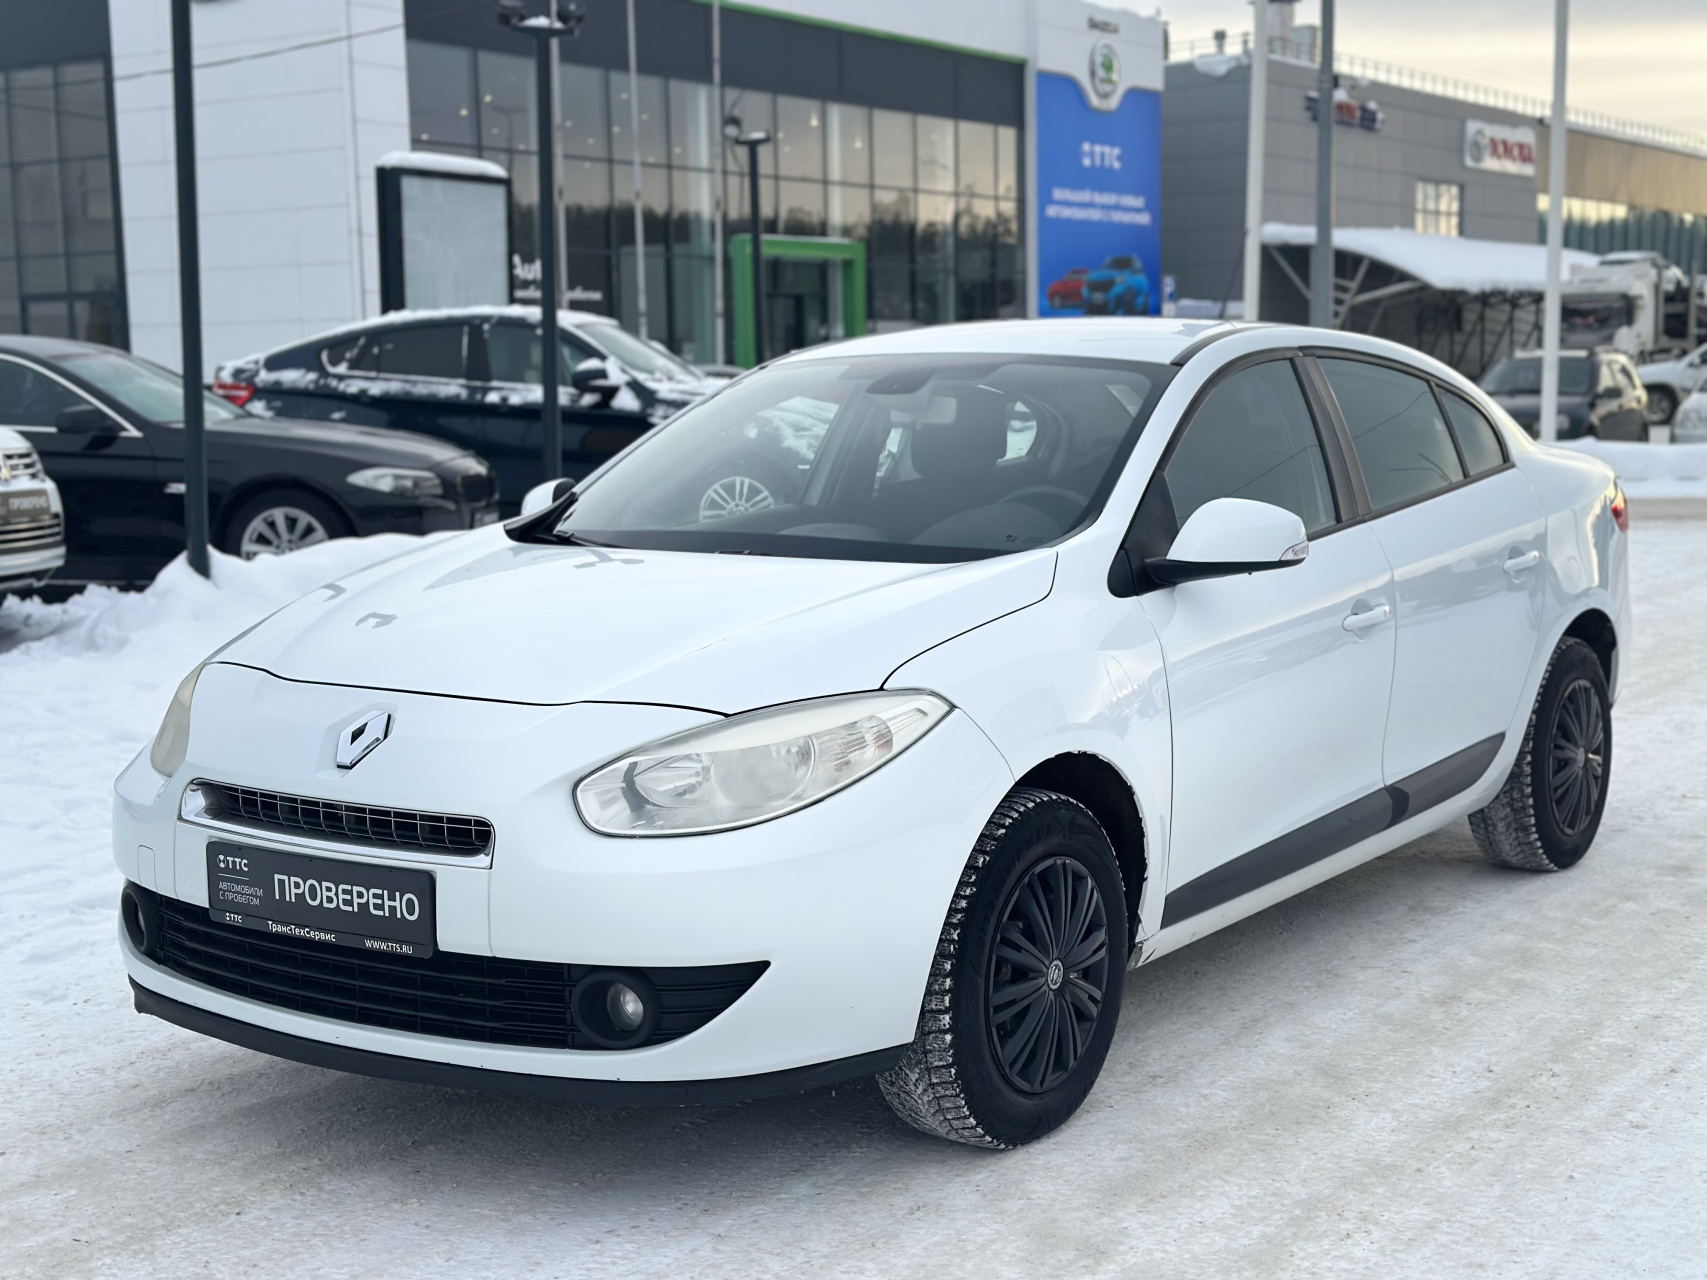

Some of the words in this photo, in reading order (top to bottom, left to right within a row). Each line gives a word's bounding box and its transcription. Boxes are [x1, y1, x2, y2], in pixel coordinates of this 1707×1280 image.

[227, 856, 249, 871] ТТС
[219, 881, 264, 897] АВТОМОБИЛИ
[273, 873, 420, 921] ПРОВЕРЕНО
[219, 890, 225, 900] С
[225, 891, 260, 906] ПРОБЕГОМ
[230, 913, 243, 923] ТТС
[267, 920, 337, 942] ТрансТехСервис
[364, 939, 413, 954] WWW.TTS.RU
